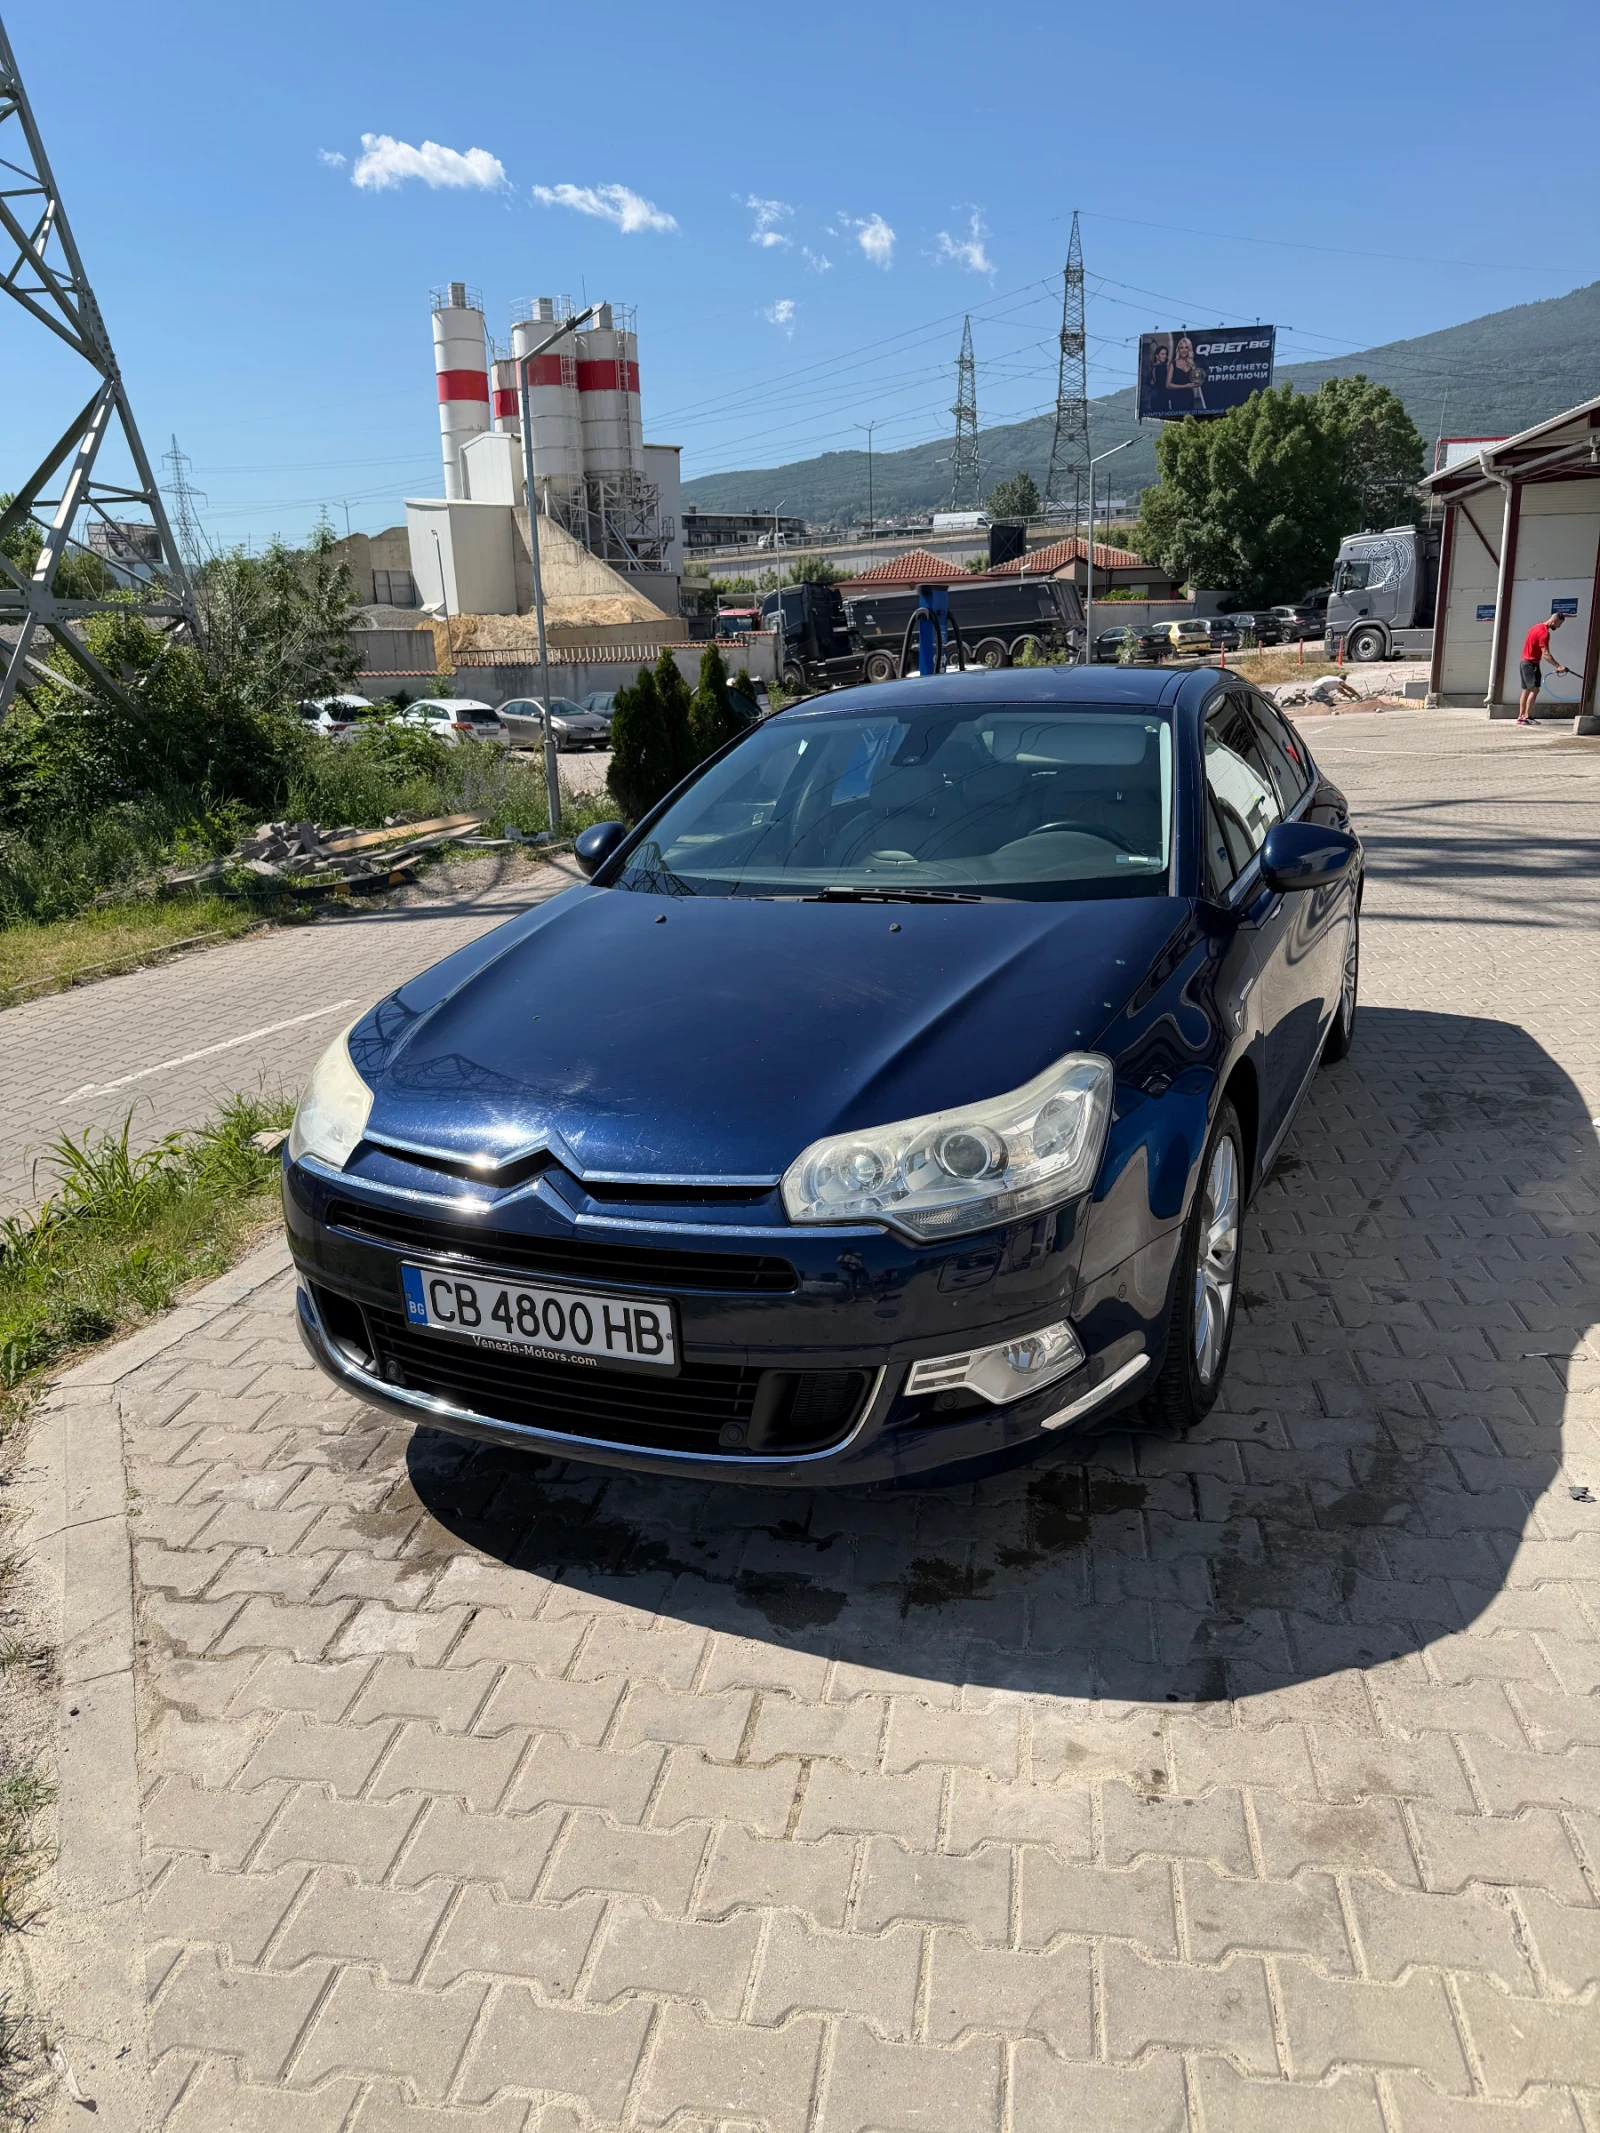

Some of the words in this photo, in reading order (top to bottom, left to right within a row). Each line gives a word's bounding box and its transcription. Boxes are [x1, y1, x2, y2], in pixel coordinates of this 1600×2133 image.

[1195, 340, 1270, 356] QBET.BG
[1209, 362, 1269, 373] ТЪРСЕНЕТО
[1207, 371, 1268, 382] ПРИКЛЮЧИ
[408, 1300, 425, 1316] BG
[429, 1279, 482, 1327] CB
[490, 1291, 594, 1346] 4800
[602, 1304, 665, 1355] HB
[472, 1335, 598, 1367] Venezia-Motors.com
